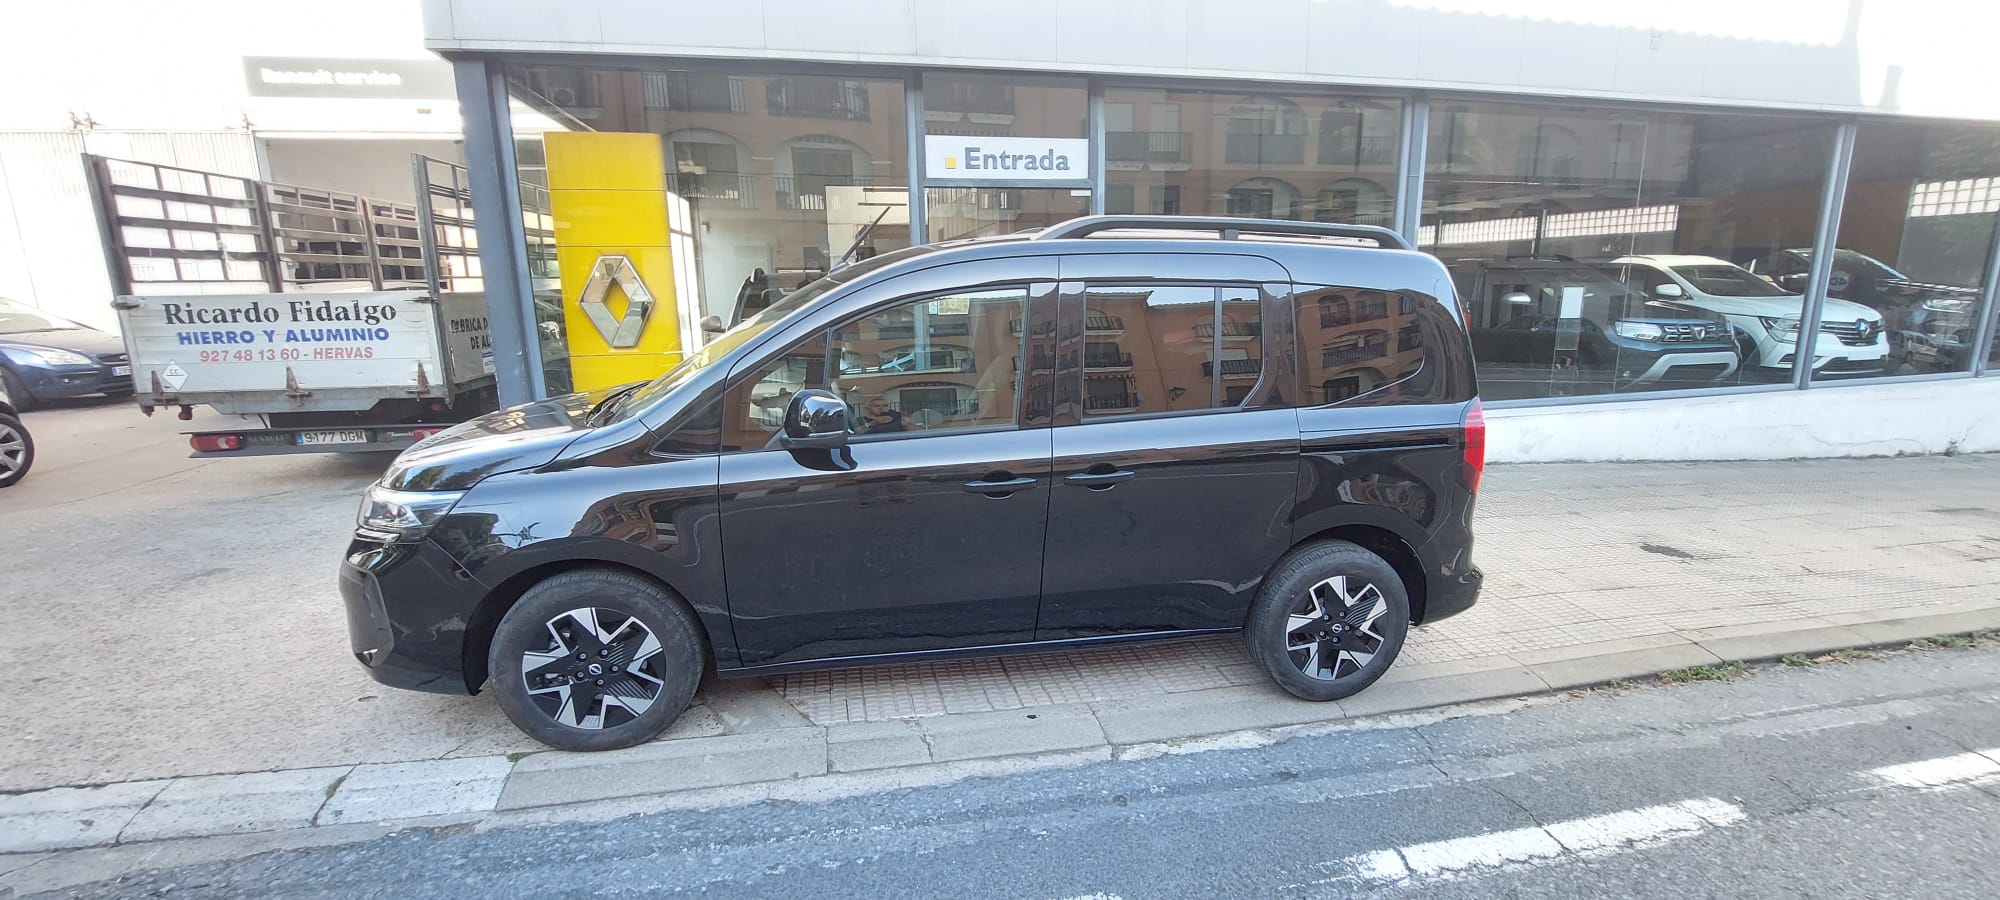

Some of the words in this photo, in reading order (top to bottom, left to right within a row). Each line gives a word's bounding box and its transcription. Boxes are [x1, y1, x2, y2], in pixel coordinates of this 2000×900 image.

[964, 146, 1070, 171] Entrada
[162, 301, 280, 325] Ricardo
[288, 299, 397, 325] Fidalgo
[177, 330, 255, 346] HIERRO
[262, 330, 276, 343] Y
[285, 327, 390, 343] ALUMINIO
[200, 350, 229, 363] 927
[233, 350, 253, 362] 48
[258, 349, 276, 361] 13
[280, 348, 300, 360] 60
[313, 346, 373, 359] HERVAS
[305, 431, 335, 443] 9177
[340, 431, 366, 442] DGM
